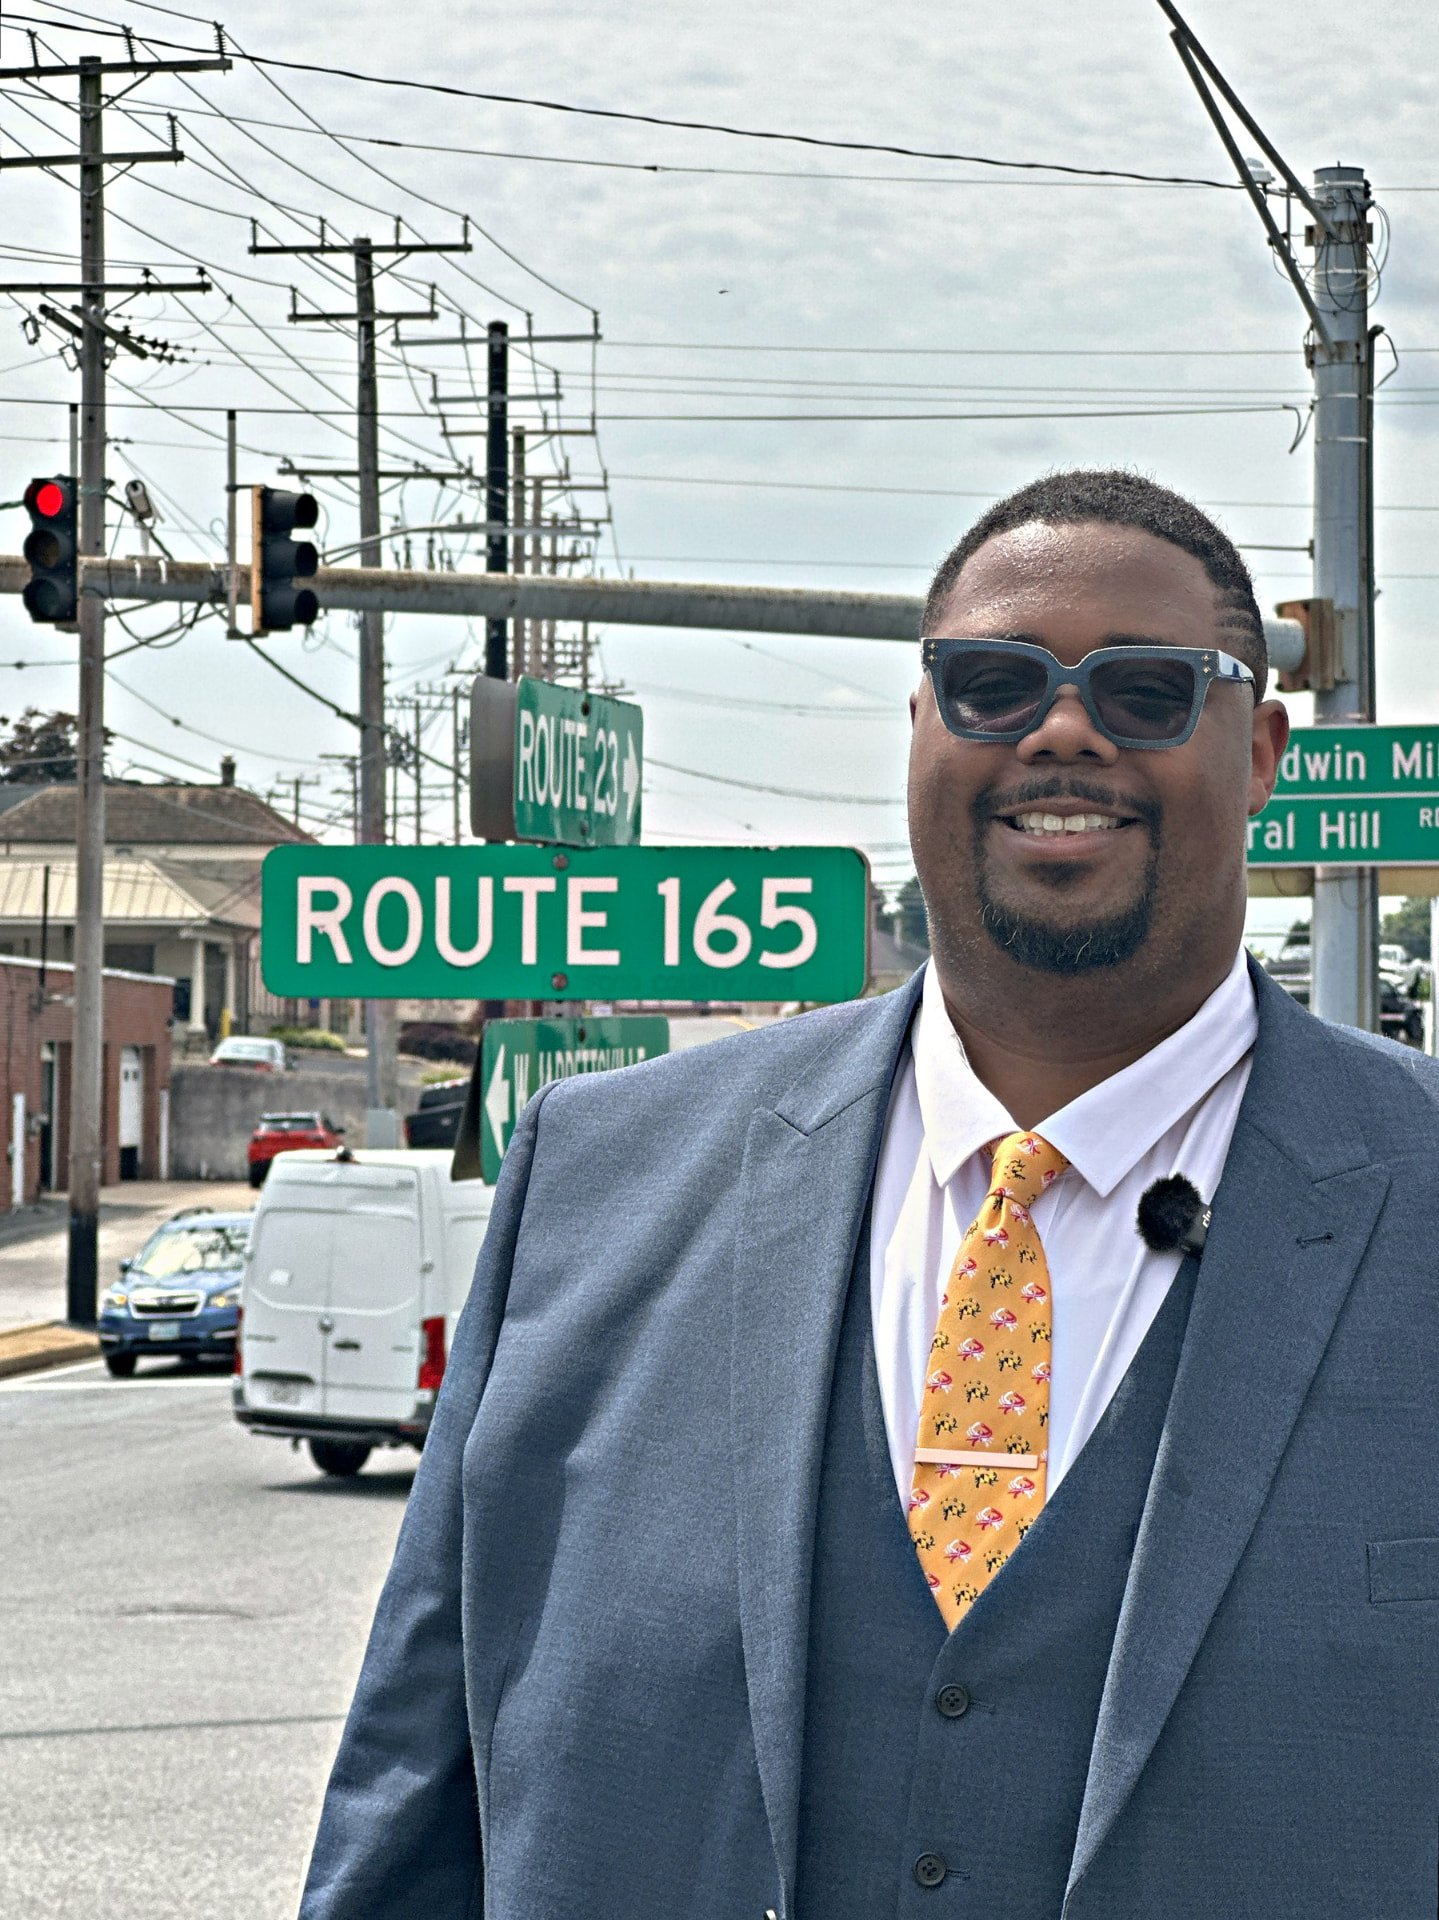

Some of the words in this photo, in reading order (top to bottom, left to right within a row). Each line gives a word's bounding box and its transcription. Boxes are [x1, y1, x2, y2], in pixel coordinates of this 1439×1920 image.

[518, 709, 588, 811] ROUTE
[594, 727, 618, 816] 23
[1392, 741, 1439, 779] Mi
[1319, 811, 1380, 849] Hill
[296, 875, 620, 967] ROUTE
[657, 876, 818, 969] 165
